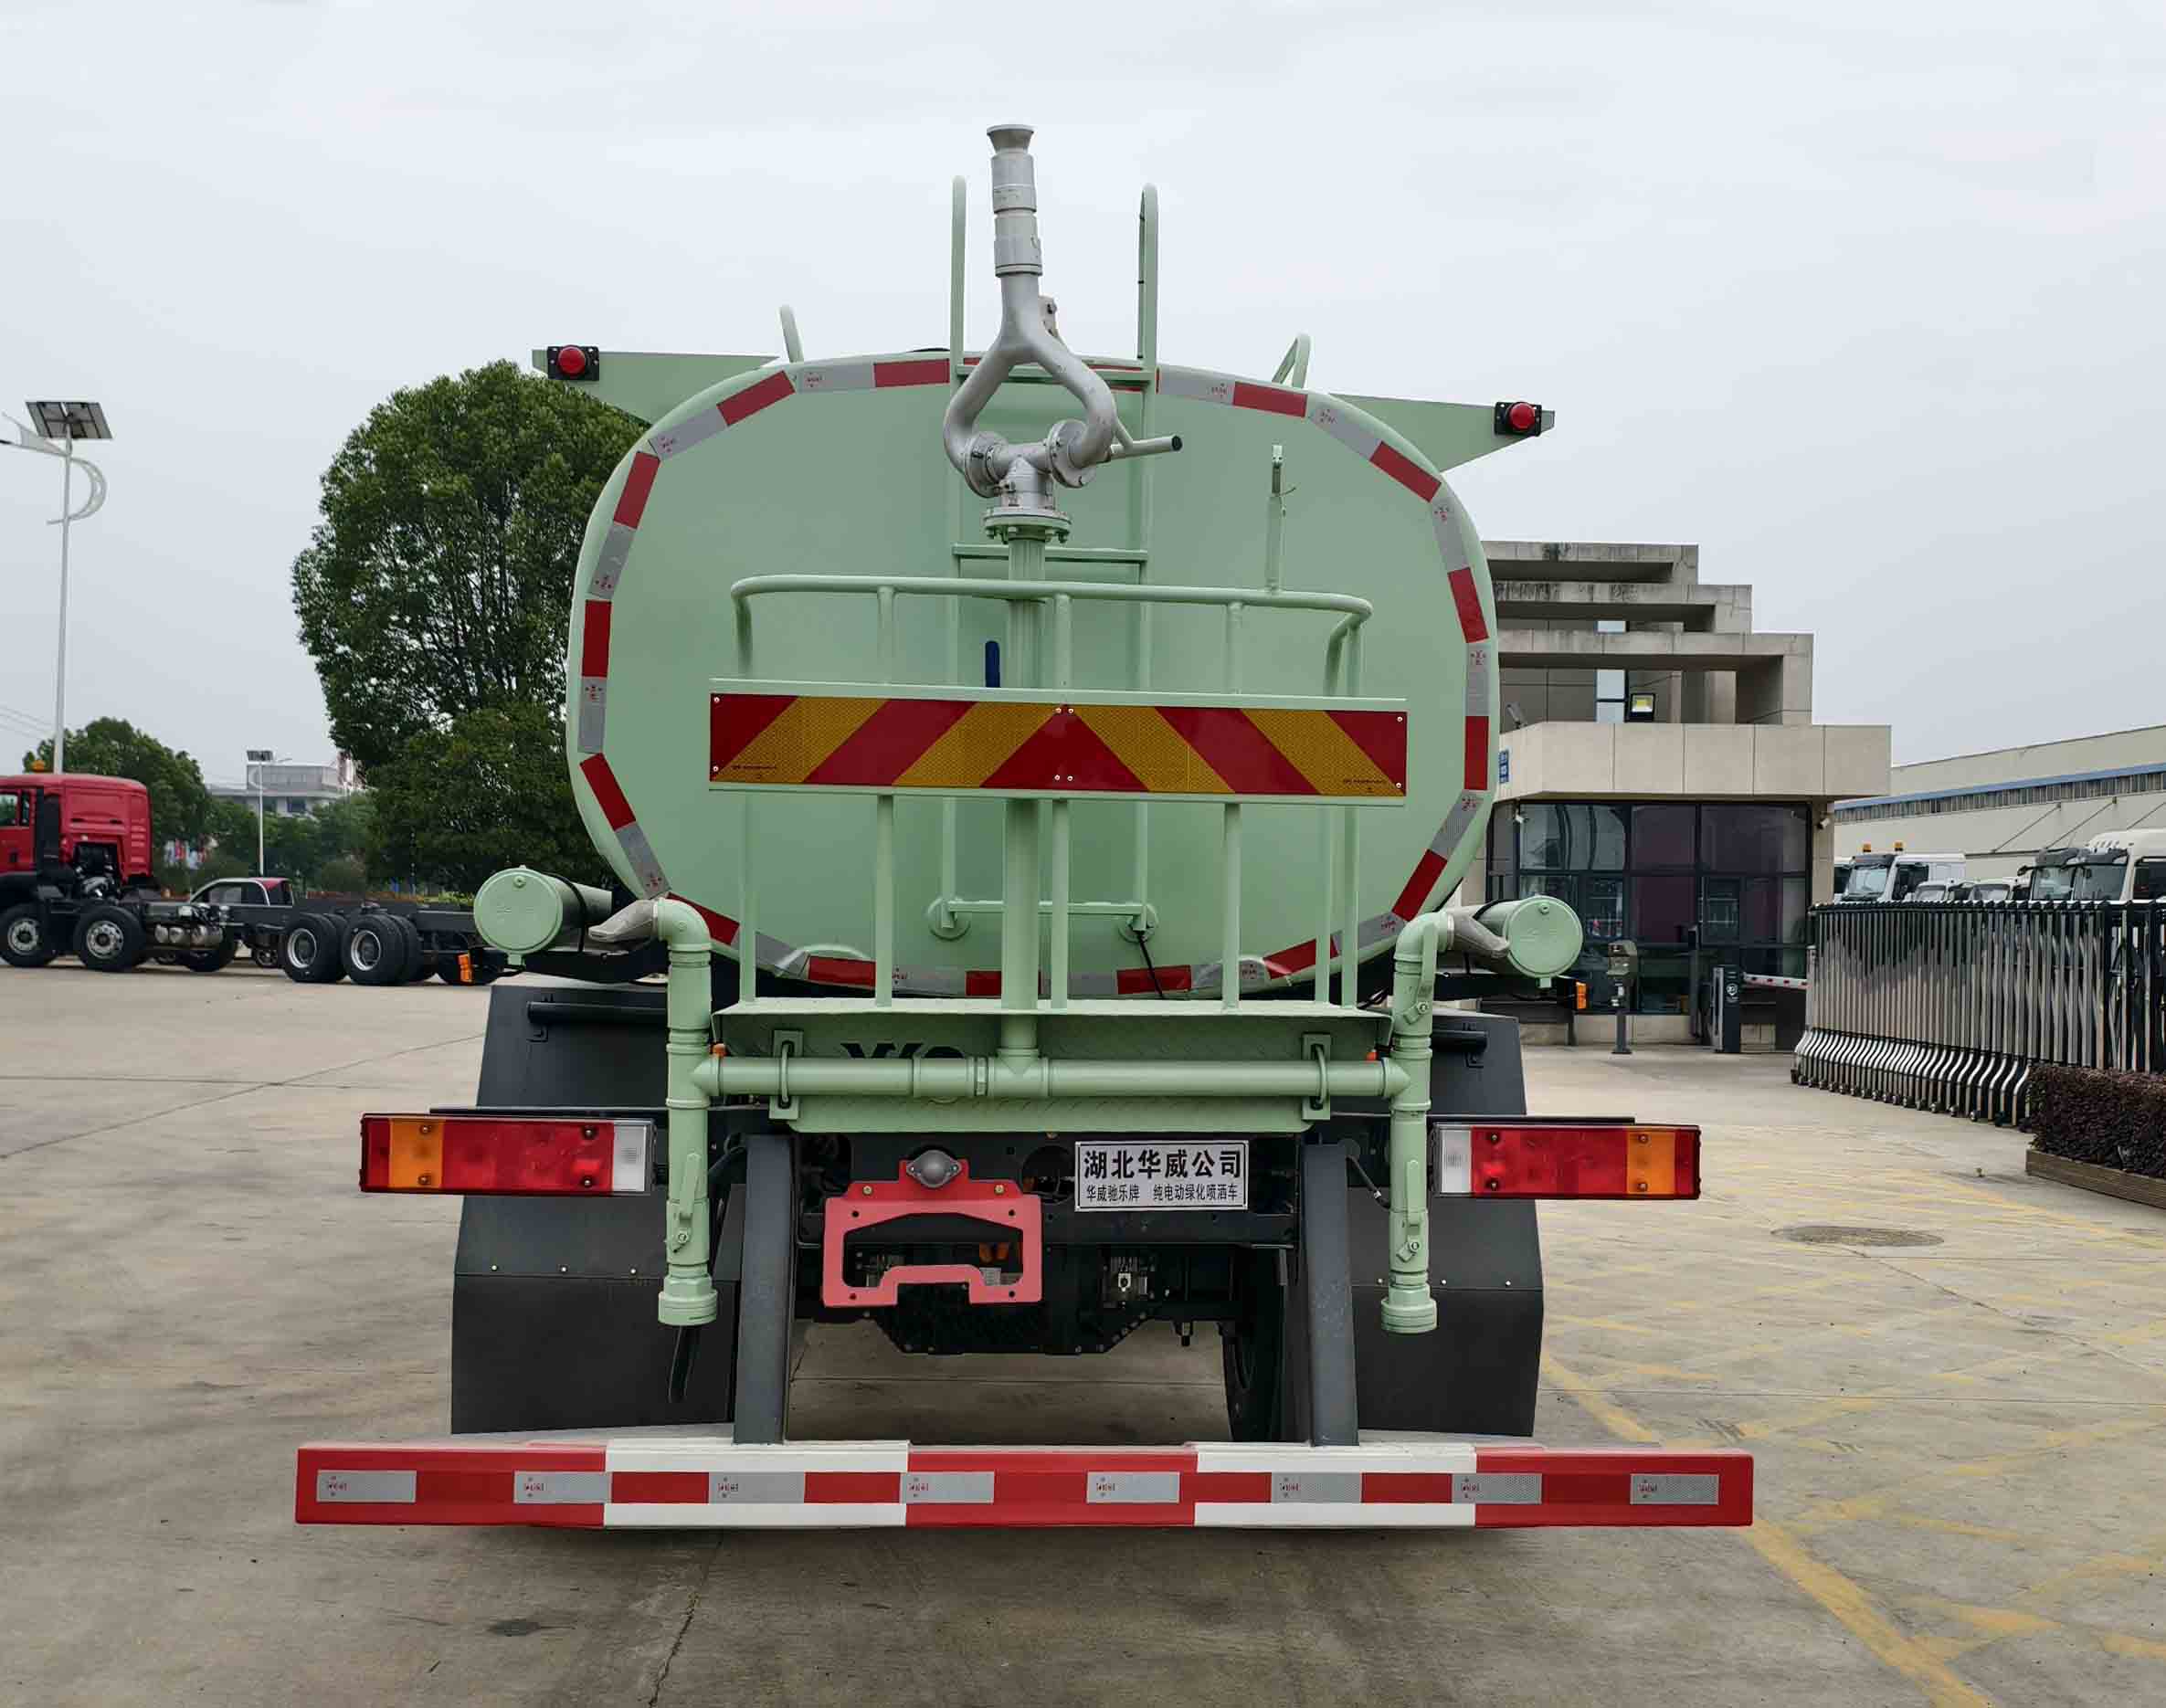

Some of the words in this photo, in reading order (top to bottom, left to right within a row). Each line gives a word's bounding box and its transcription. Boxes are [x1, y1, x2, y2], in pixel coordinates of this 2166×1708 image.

[1083, 1148, 1241, 1180] 湖北华威公司
[1086, 1184, 1141, 1202] 华威驰乐牌
[1153, 1184, 1238, 1202] 纯电动绿化喷洒车
